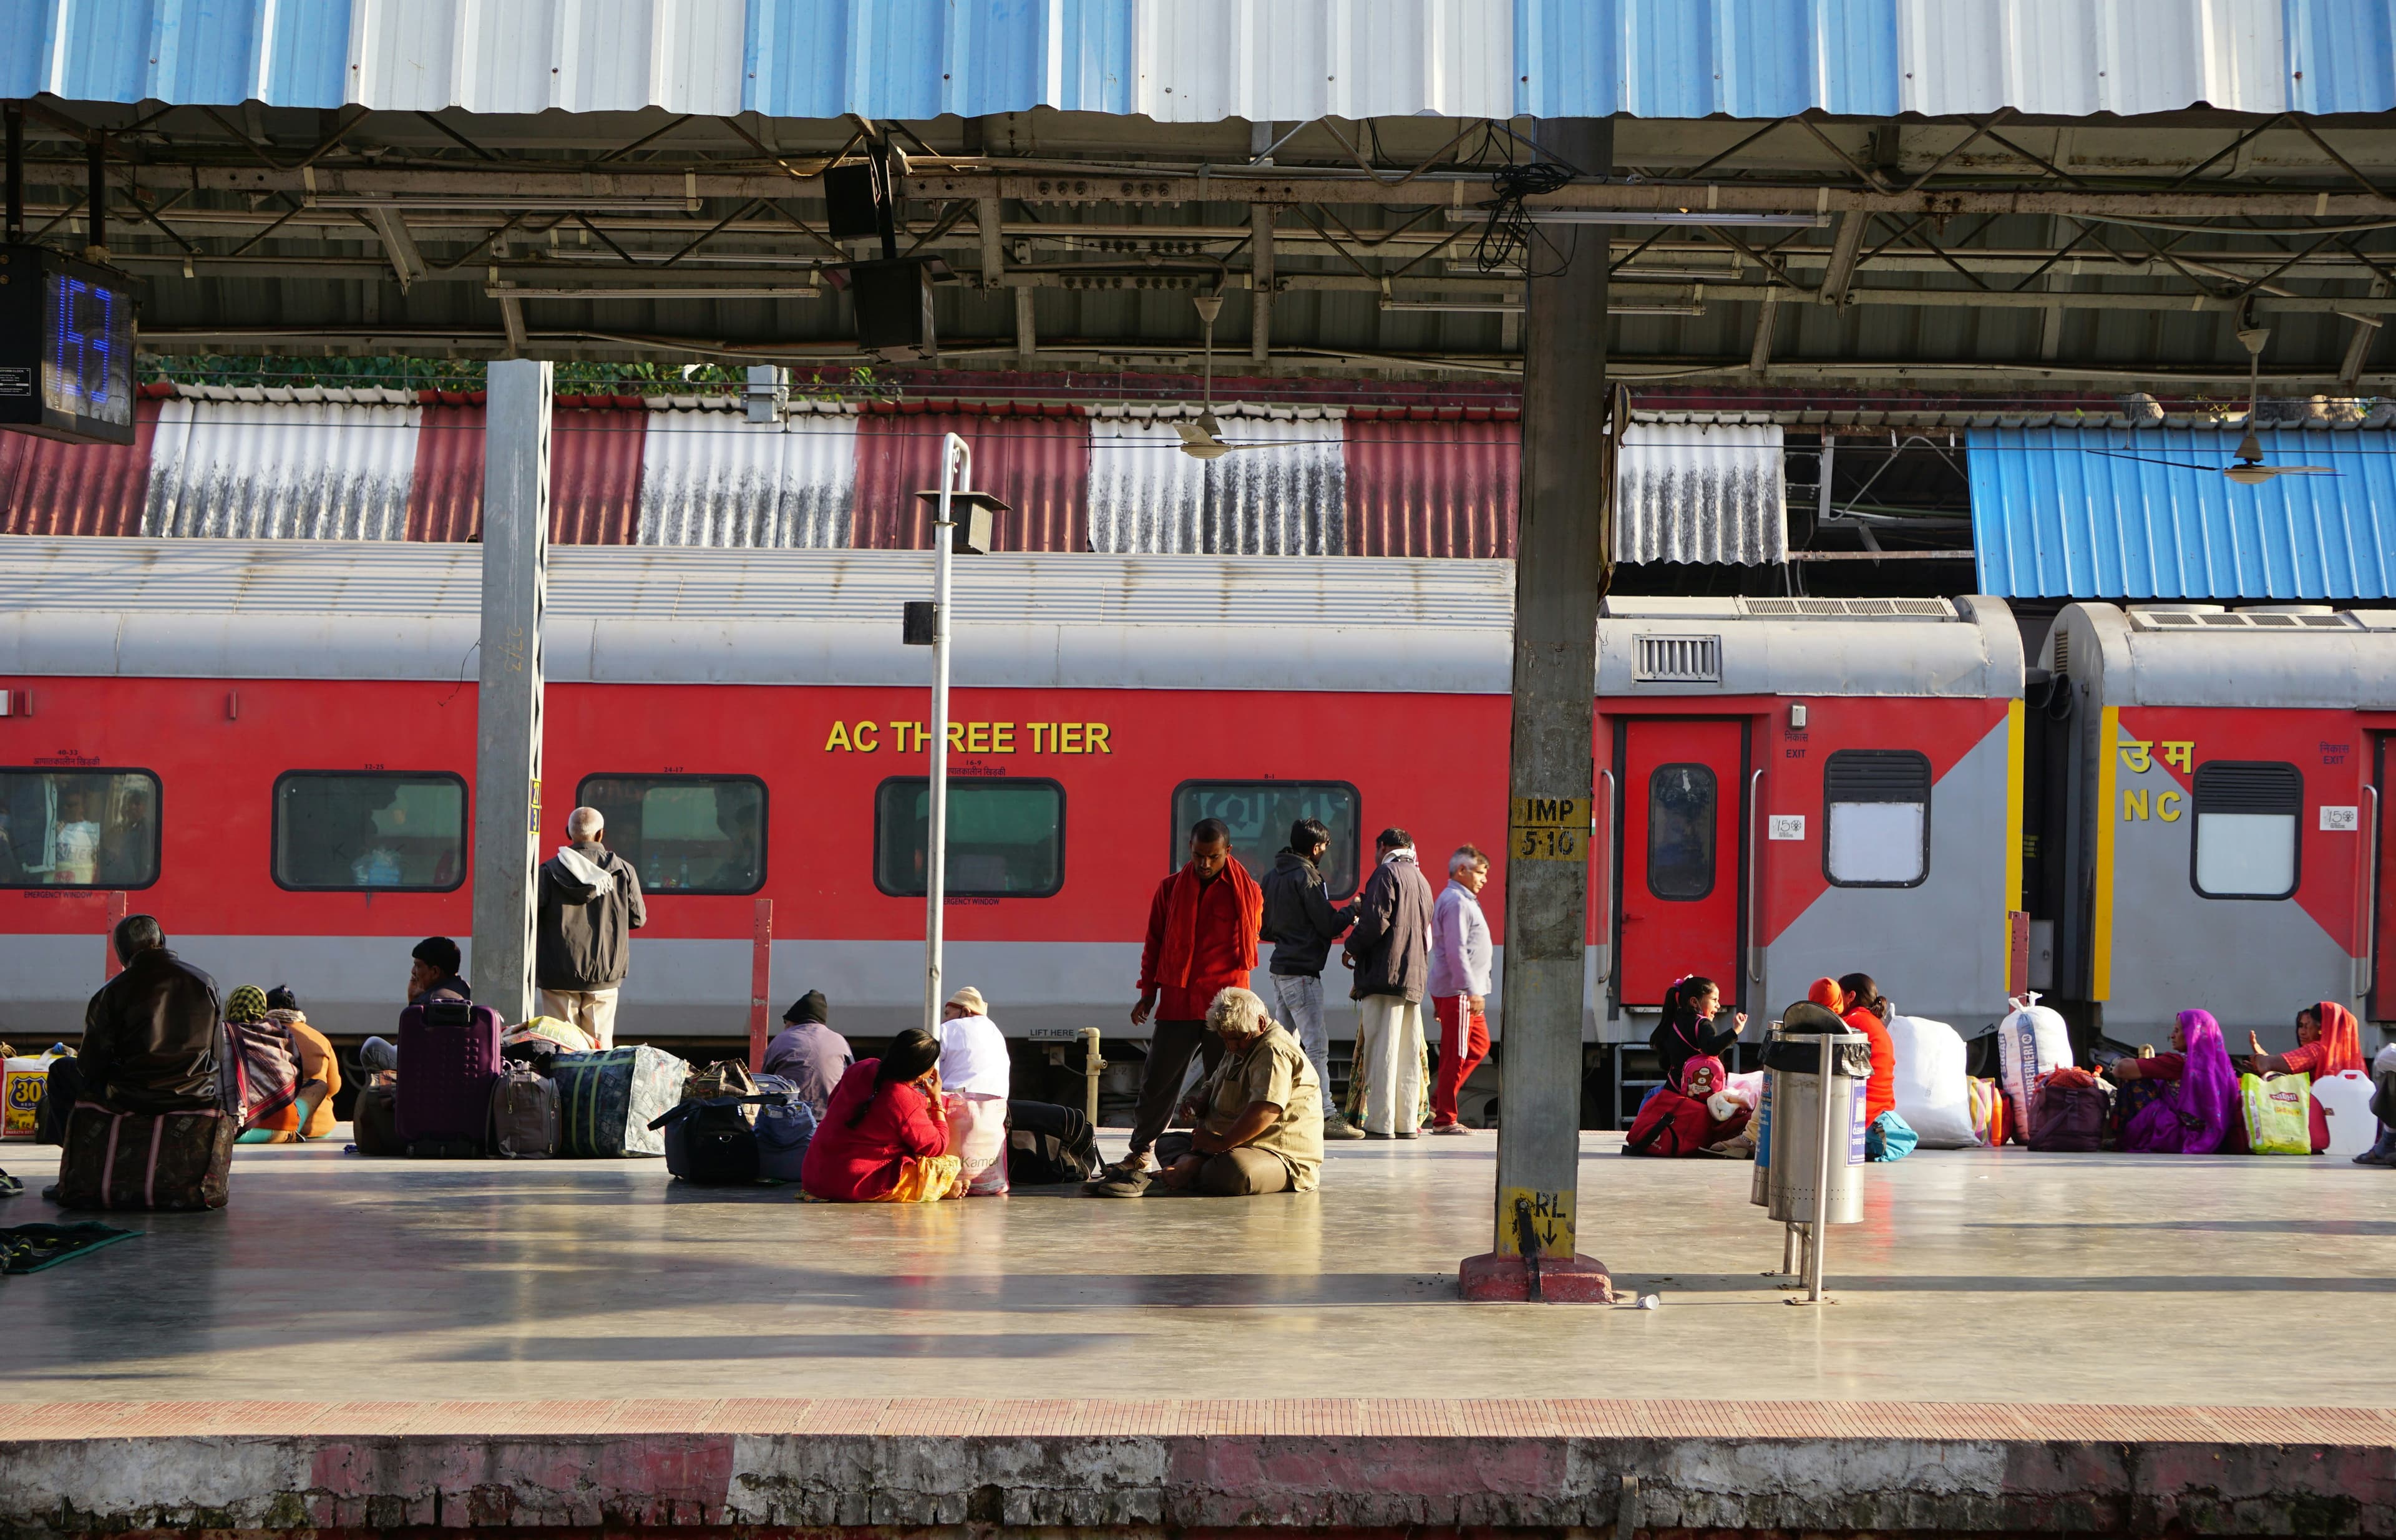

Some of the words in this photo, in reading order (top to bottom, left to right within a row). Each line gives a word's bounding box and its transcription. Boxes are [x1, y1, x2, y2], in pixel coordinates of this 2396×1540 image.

[825, 721, 879, 753] AC
[890, 721, 1016, 753] THREE
[1026, 723, 1112, 754] TIER
[1785, 730, 1808, 743] निकास
[1786, 749, 1806, 758] EXIT
[2323, 756, 2345, 764] EXIT
[1527, 799, 1574, 822] IMP
[1999, 1034, 2008, 1073] SUGAR
[15, 1081, 42, 1103] 30
